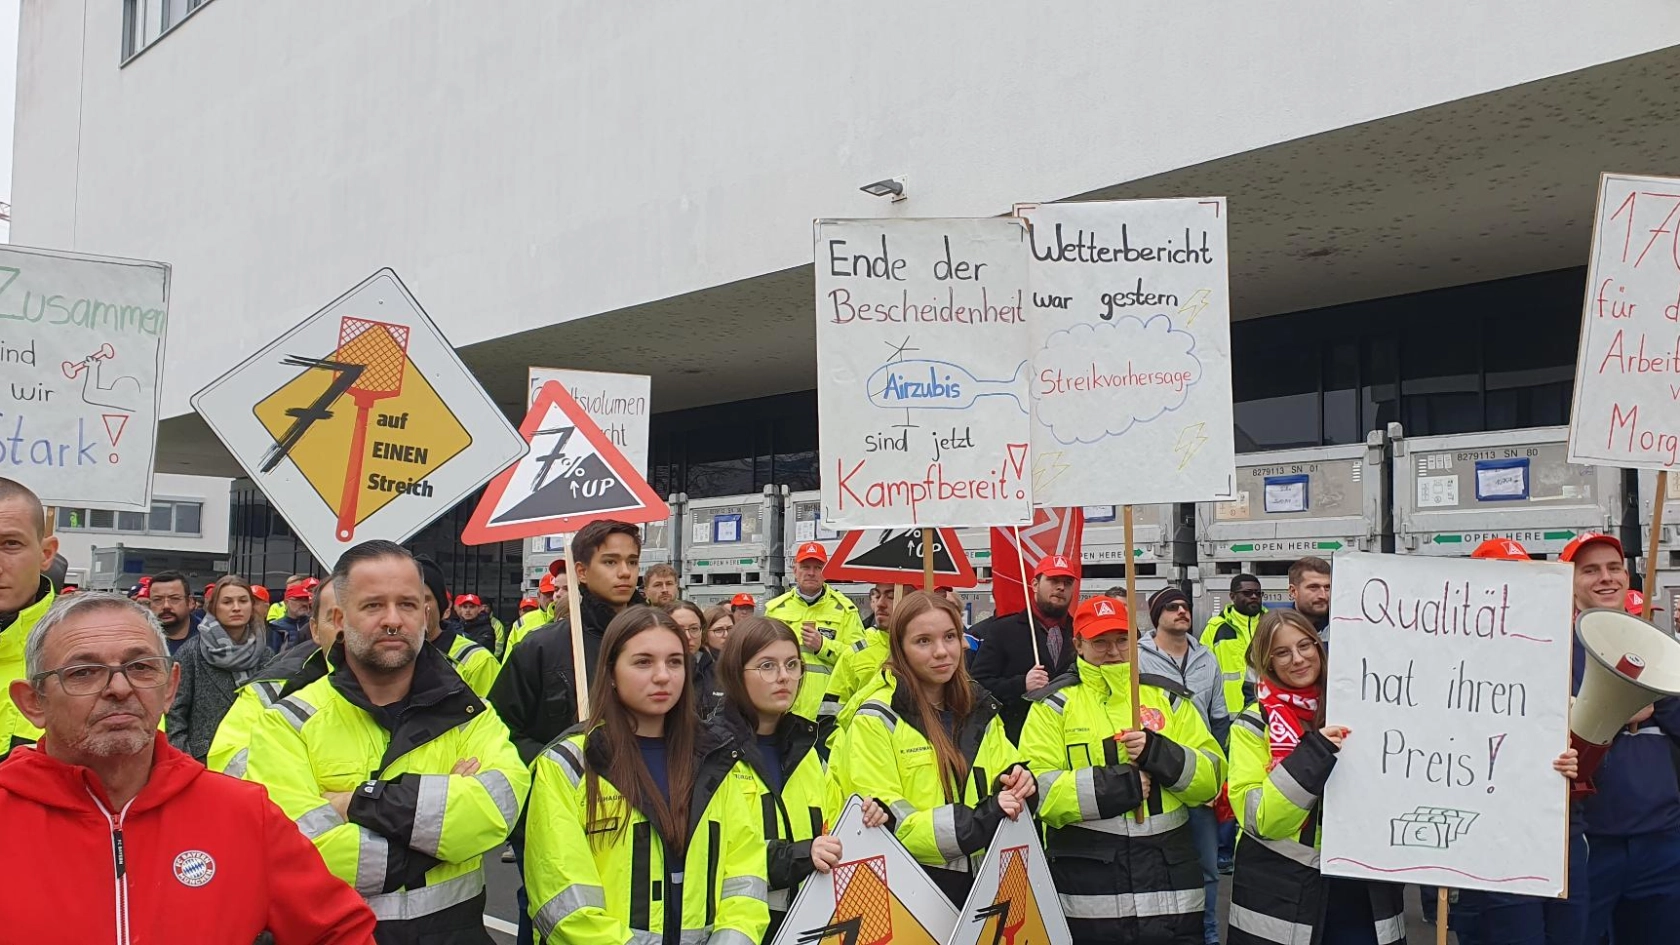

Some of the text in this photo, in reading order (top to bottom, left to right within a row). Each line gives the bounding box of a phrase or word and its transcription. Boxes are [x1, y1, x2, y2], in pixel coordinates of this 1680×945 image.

[829, 234, 989, 282] Ende der
[1028, 222, 1214, 266] Wetterbericht
[0, 265, 166, 336] Zusammen
[828, 286, 1027, 325] Bescheidenheit
[1033, 277, 1179, 321] war gestern
[1597, 278, 1636, 318] für
[12, 382, 55, 402] wir
[883, 366, 962, 400] Airzubis
[1040, 361, 1192, 397] Streikvorhersage
[259, 352, 367, 475] 7
[376, 411, 410, 431] auf
[372, 441, 429, 466] EINEN
[865, 426, 975, 462] sind jetzt
[1457, 448, 1539, 462] 8279113 SN 80
[367, 472, 434, 499] Streich
[582, 477, 615, 498] UP
[837, 443, 1029, 524] Kampfbereit!
[1252, 466, 1285, 477] 8279113
[1291, 465, 1303, 473] SN
[1254, 541, 1317, 551] OPEN HERE
[1464, 531, 1541, 542] OPEN HERE
[1099, 551, 1122, 559] HERE
[1361, 577, 1511, 639] Qualität
[1361, 657, 1419, 708] hat
[1447, 659, 1527, 717] ihren
[1382, 728, 1508, 795] Preis!
[181, 851, 212, 864] BAYERN
